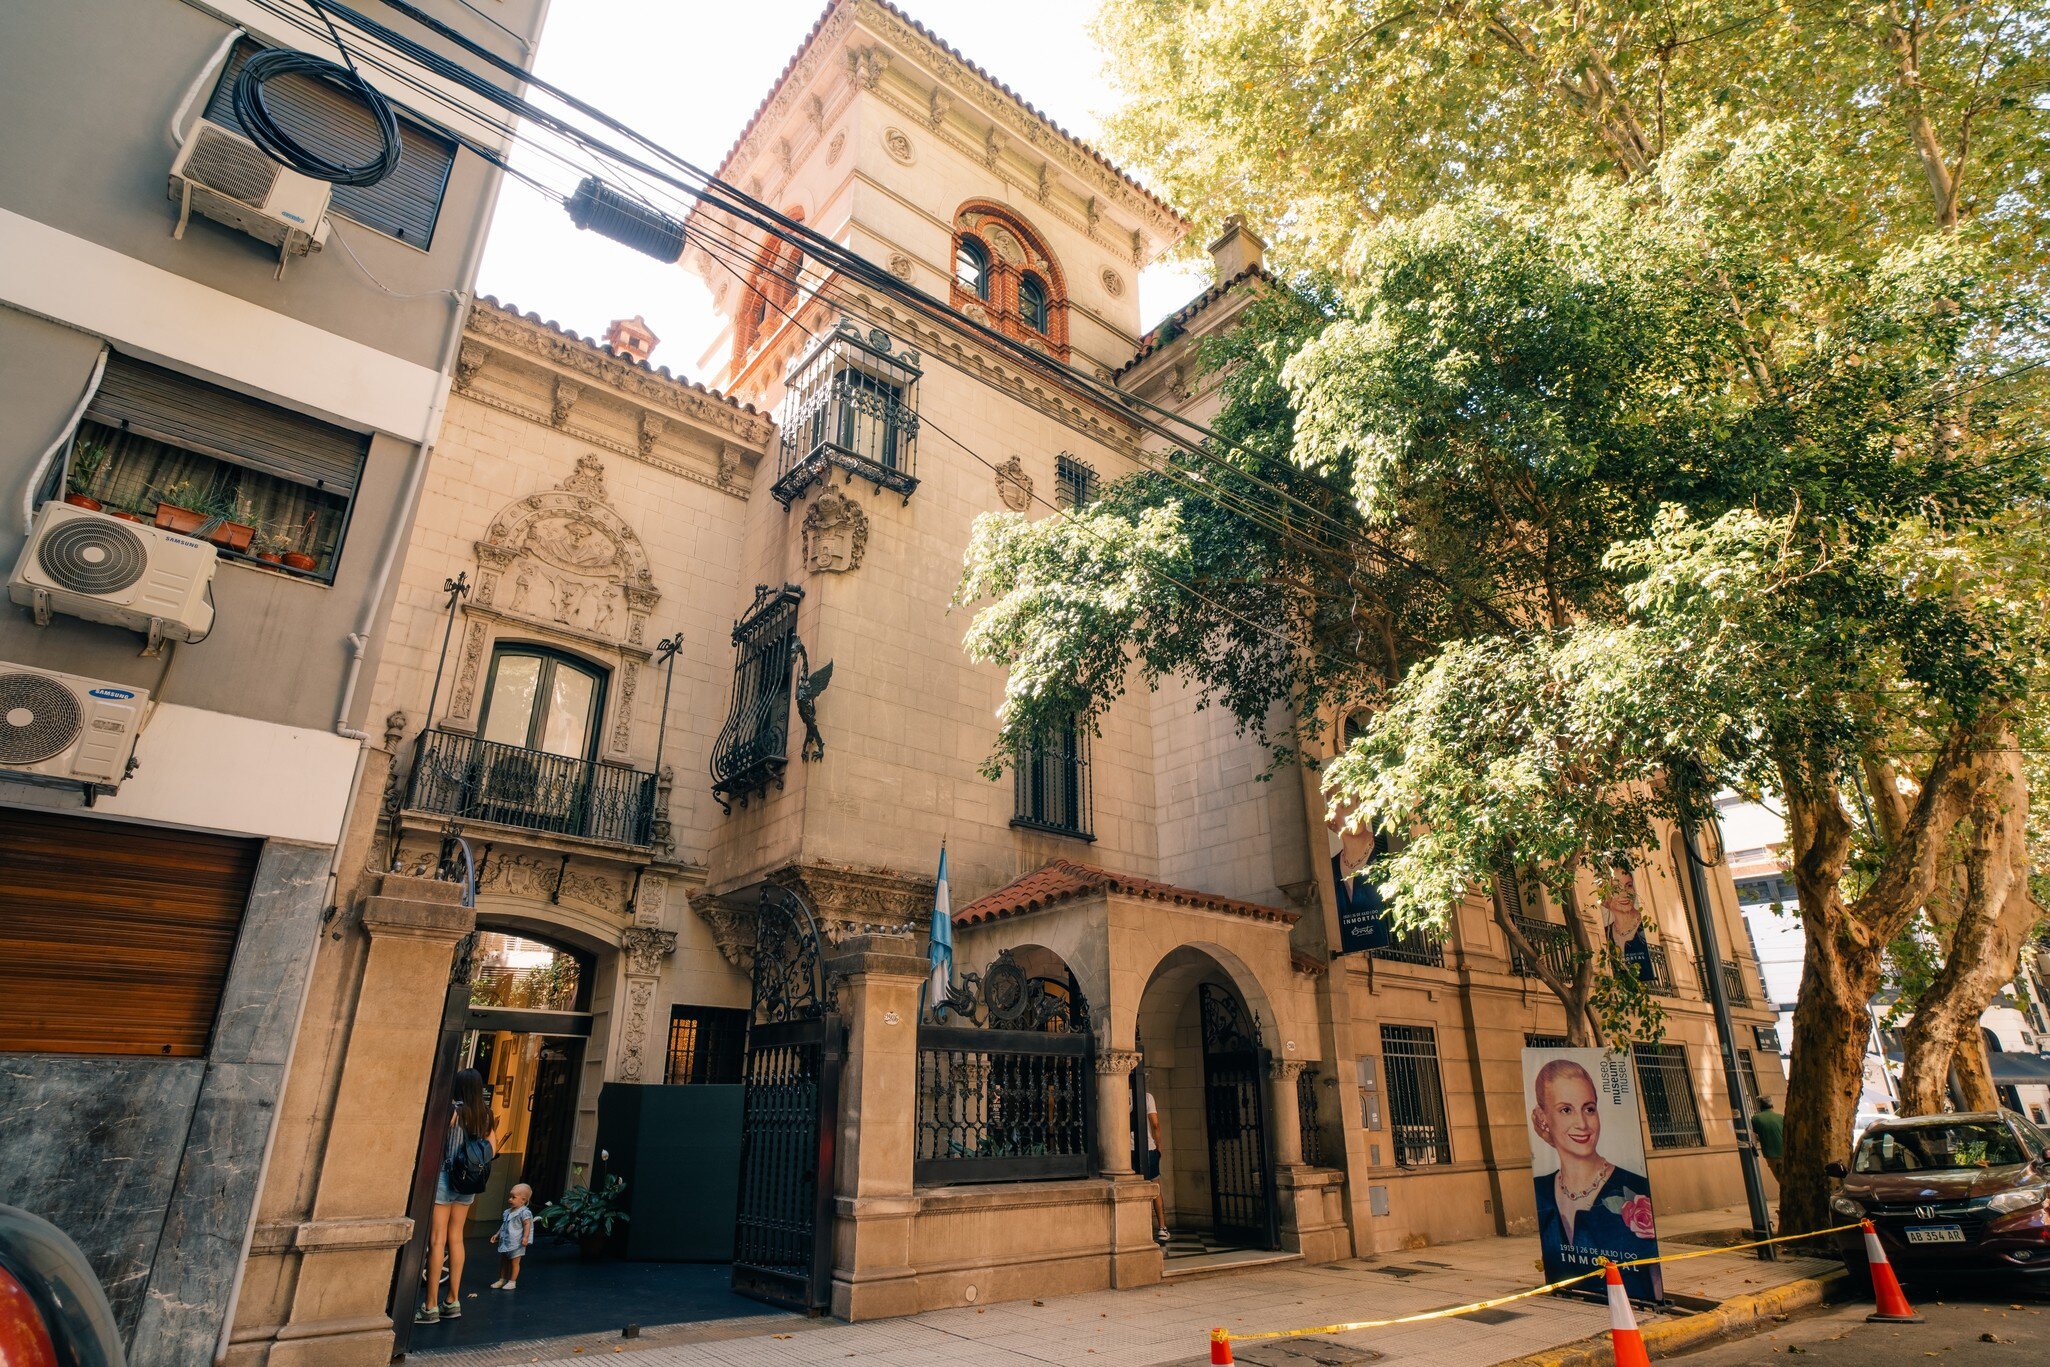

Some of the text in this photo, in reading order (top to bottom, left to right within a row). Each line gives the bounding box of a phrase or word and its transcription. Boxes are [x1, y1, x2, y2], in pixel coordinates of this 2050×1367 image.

[165, 536, 199, 549] SAMSUNG
[95, 689, 130, 700] SAMSUNG
[1343, 914, 1379, 924] INMORTAL
[1599, 1061, 1611, 1093] museo
[1609, 1061, 1622, 1105] museum
[1617, 1061, 1630, 1094] museu
[1910, 1230, 1962, 1242] AB 354 AR
[1560, 1244, 1575, 1252] 1919
[1580, 1246, 1588, 1254] 26
[1589, 1247, 1598, 1255] DE
[1600, 1249, 1618, 1258] JULIO
[1561, 1253, 1639, 1272] INMOTAL
